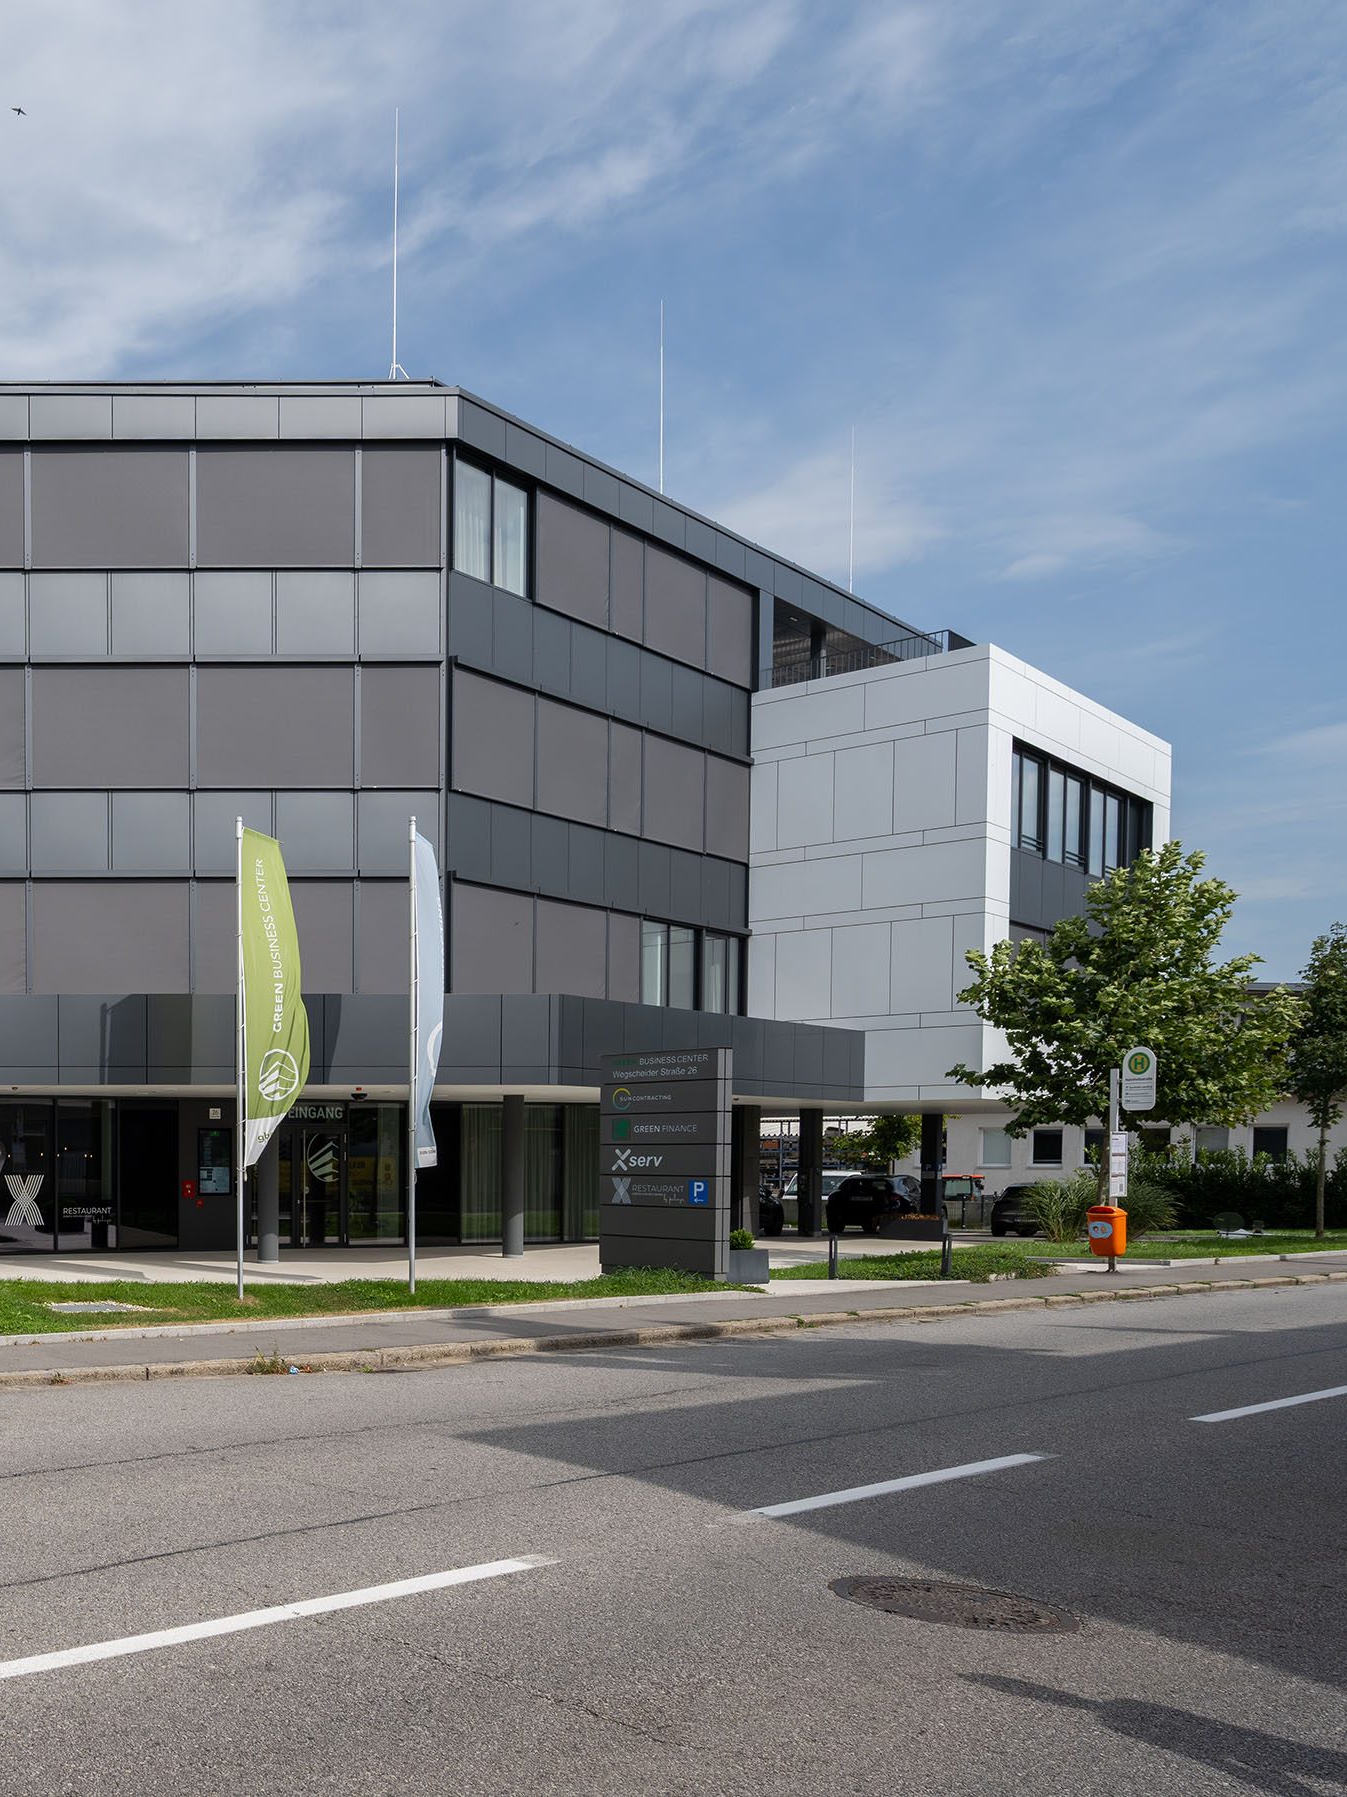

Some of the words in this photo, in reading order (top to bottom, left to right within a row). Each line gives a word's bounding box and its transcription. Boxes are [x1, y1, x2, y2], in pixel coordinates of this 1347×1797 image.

[255, 858, 271, 912] CENTER
[263, 915, 283, 979] BUSINESS
[273, 983, 284, 1033] GREEN
[640, 1056, 676, 1065] BUSINESS
[677, 1054, 709, 1062] CENTER
[1134, 1058, 1144, 1070] H
[613, 1068, 659, 1079] Wegscheider
[661, 1066, 686, 1076] Straße
[688, 1066, 698, 1075] 26
[288, 1107, 343, 1119] EINGANG
[634, 1125, 660, 1133] GREEN
[662, 1124, 697, 1132] FINANCE
[258, 1132, 270, 1143] gb
[694, 1182, 704, 1197] P
